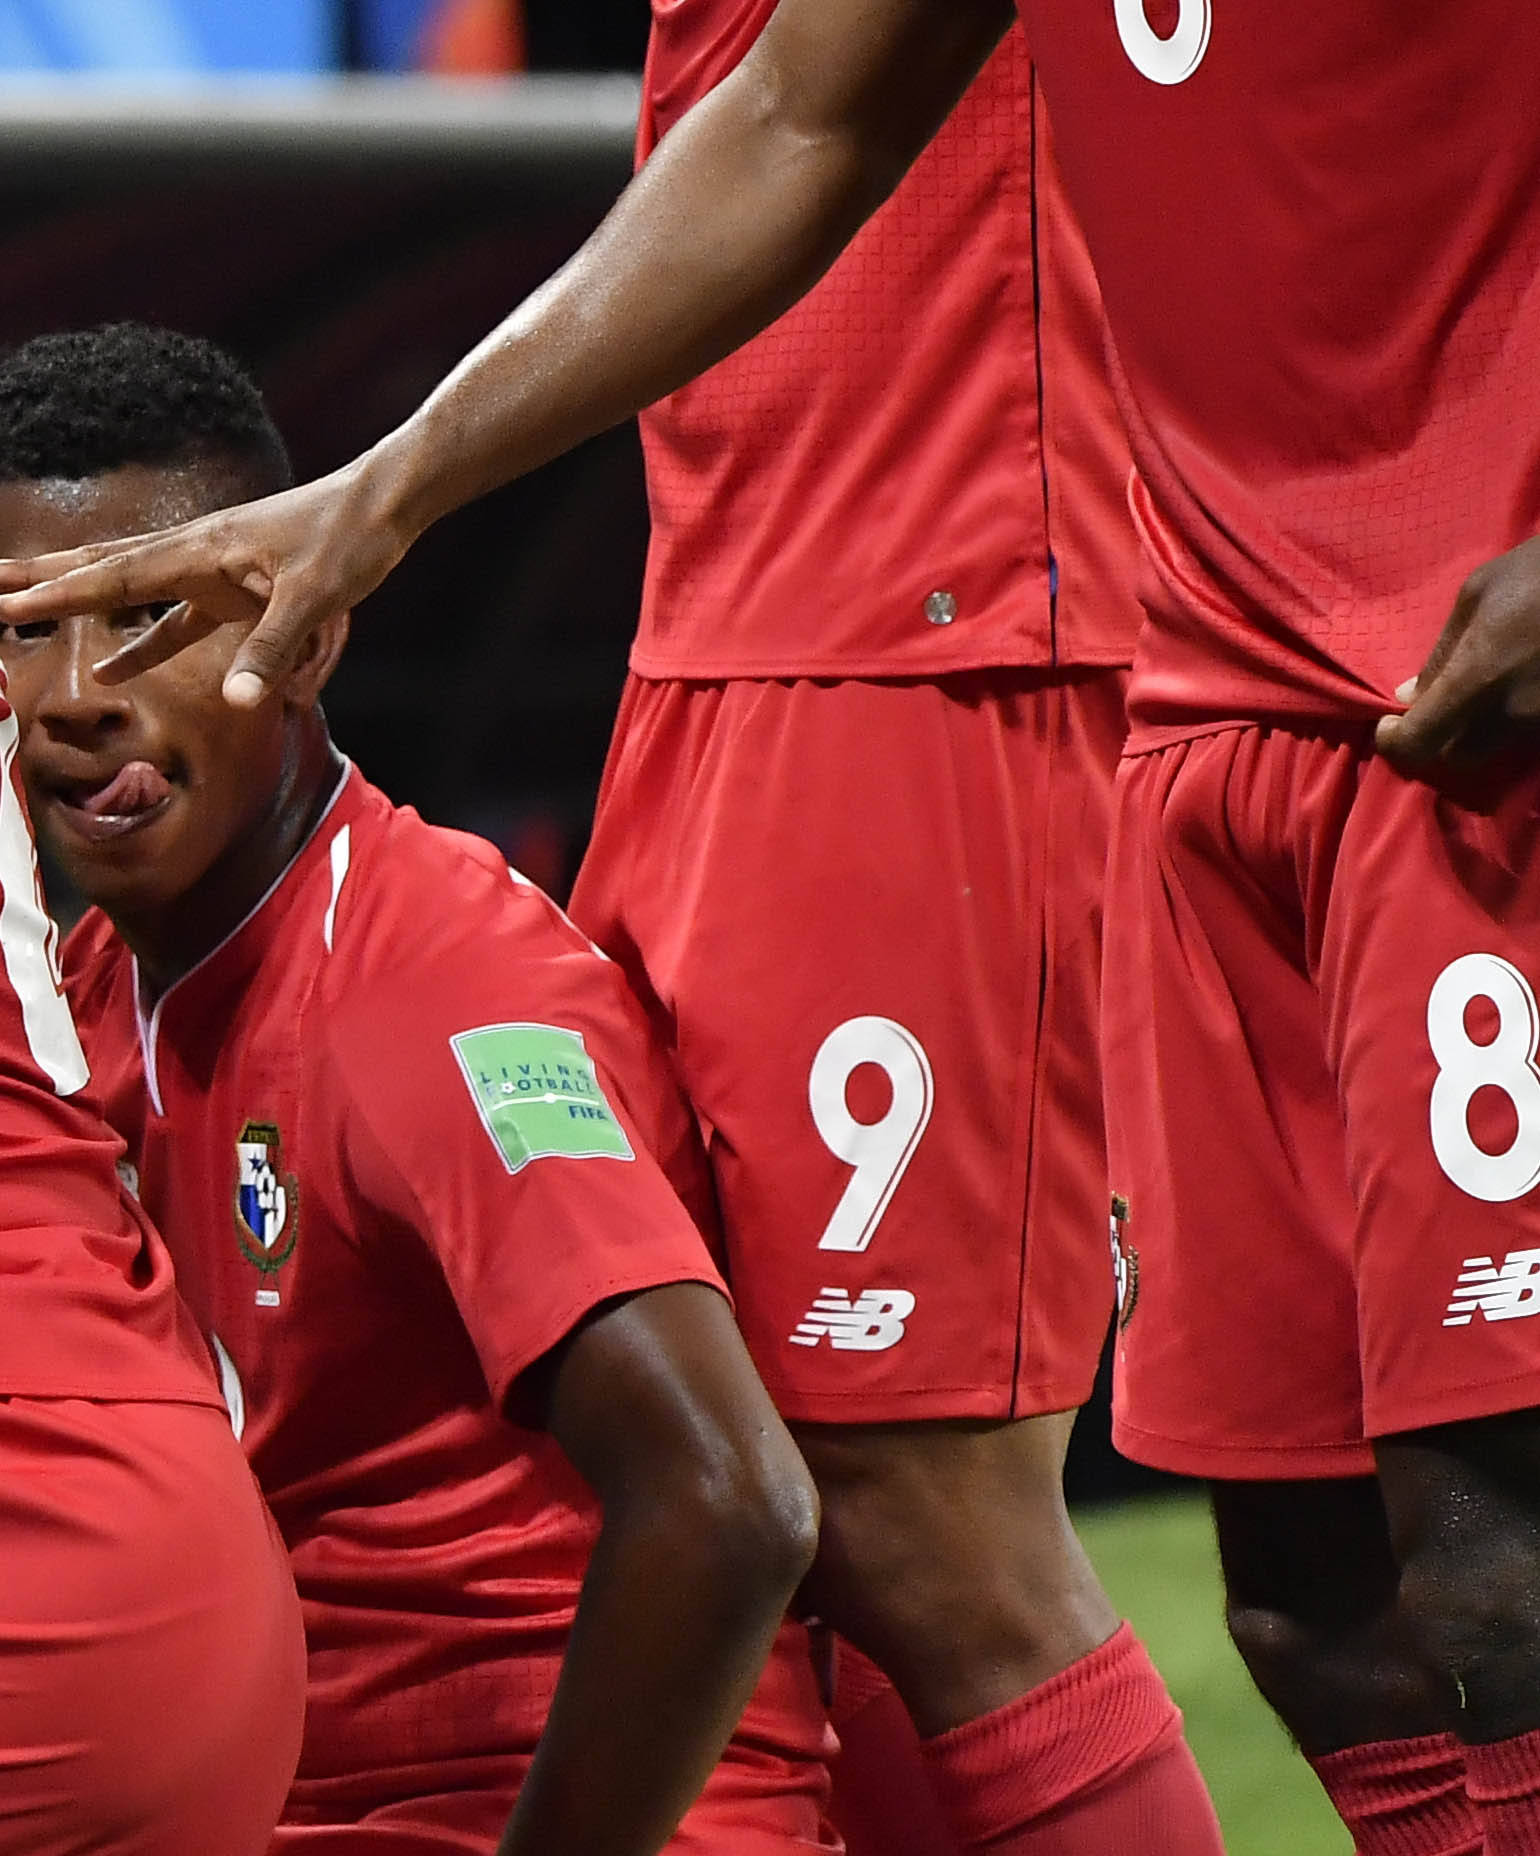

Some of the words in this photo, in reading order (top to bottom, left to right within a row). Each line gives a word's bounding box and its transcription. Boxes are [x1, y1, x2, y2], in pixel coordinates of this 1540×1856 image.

[568, 1105, 608, 1120] FIFA
[808, 1015, 935, 1253] 9
[1426, 952, 1540, 1203] 8
[788, 1286, 916, 1351] NB
